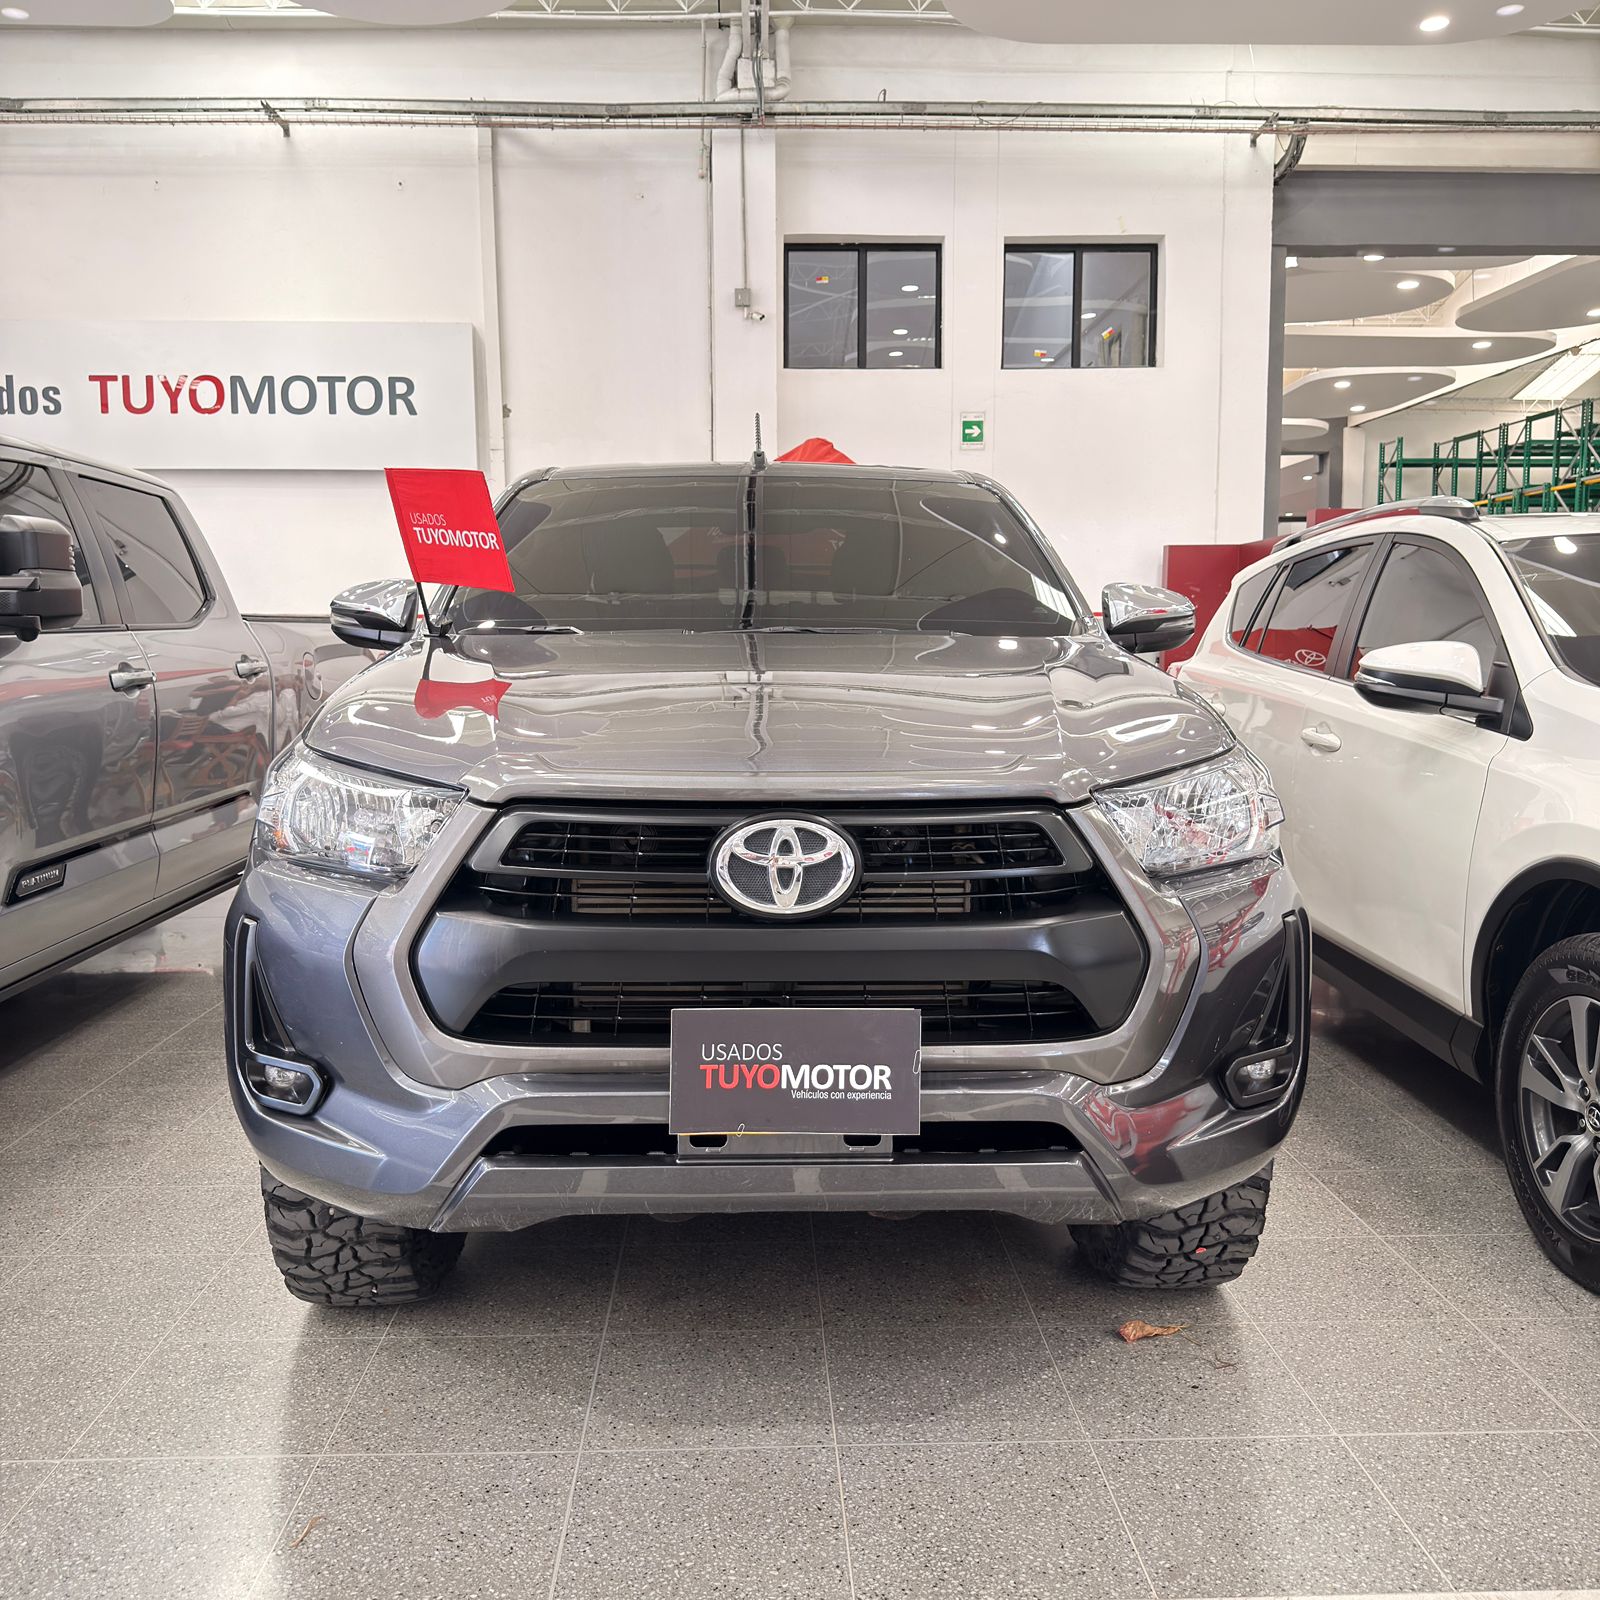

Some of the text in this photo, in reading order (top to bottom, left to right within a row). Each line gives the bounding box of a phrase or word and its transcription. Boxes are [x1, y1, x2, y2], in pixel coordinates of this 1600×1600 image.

[0, 374, 418, 416] dos TUYOMOTOR
[409, 512, 447, 526] USADOS
[413, 527, 500, 550] TUYOMOTOR
[701, 1043, 783, 1061] USADOS
[699, 1064, 892, 1090] TUYOMOTOR
[791, 1089, 892, 1100] Vehículos con experiencia
